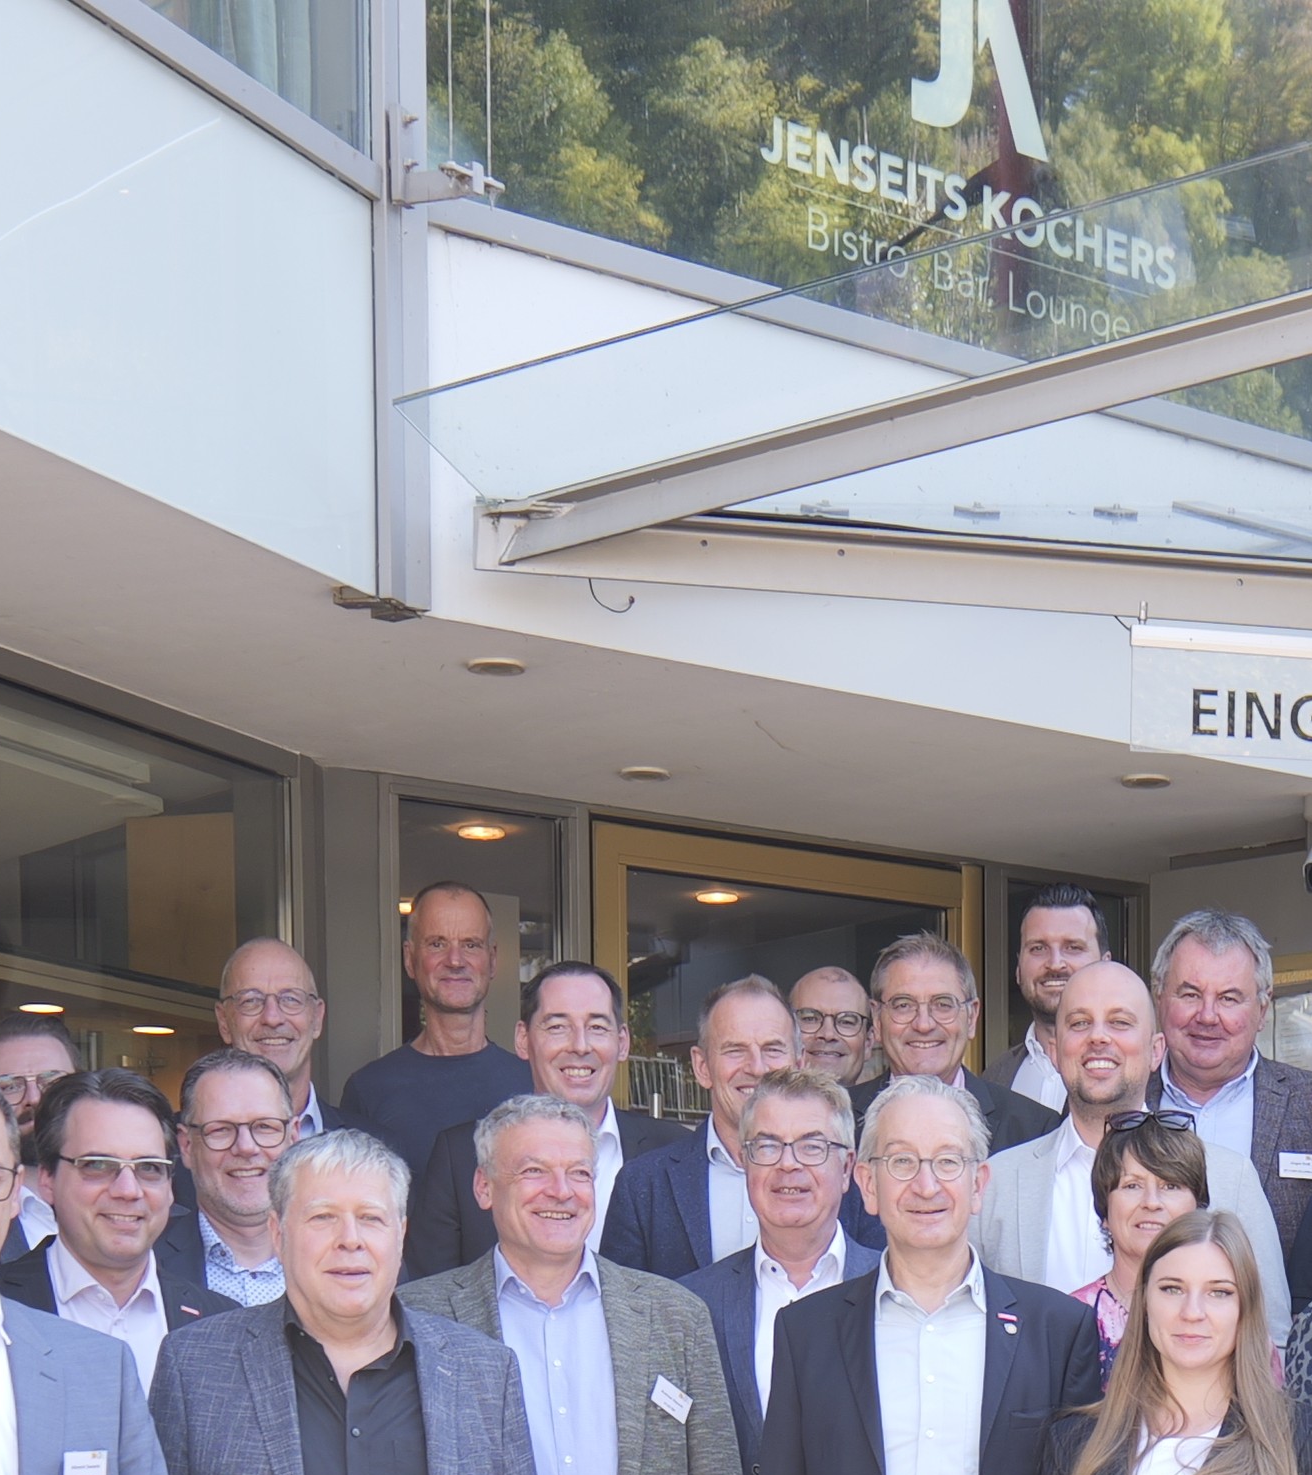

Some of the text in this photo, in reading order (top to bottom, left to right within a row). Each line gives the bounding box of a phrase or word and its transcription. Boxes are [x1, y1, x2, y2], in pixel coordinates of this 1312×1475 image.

[760, 115, 1177, 290] JENSEITS KOCHERS
[1009, 270, 1131, 345] Lounge
